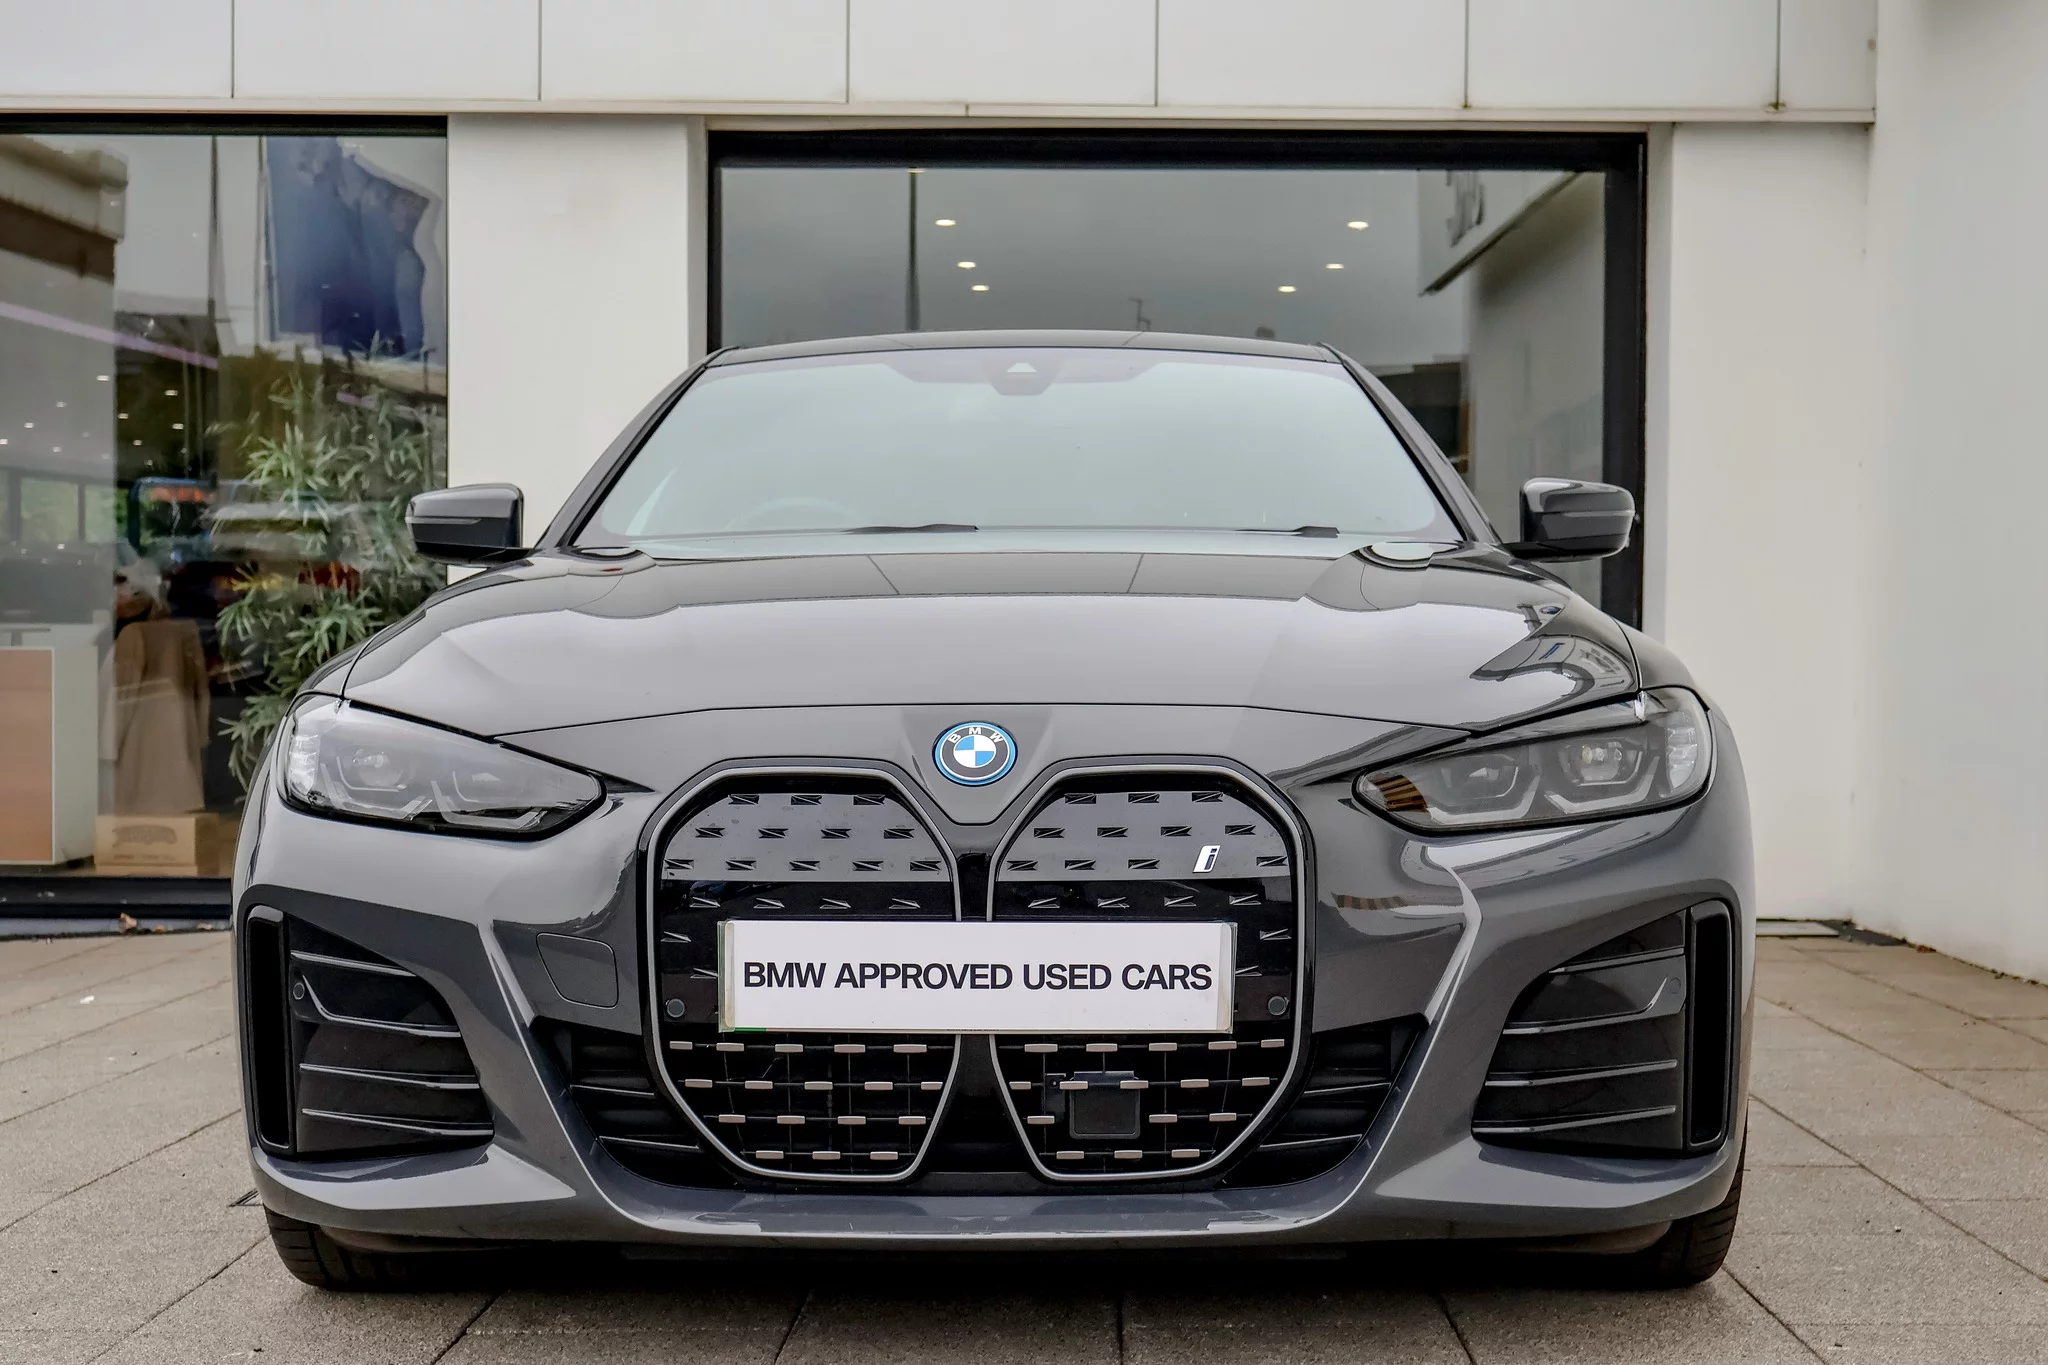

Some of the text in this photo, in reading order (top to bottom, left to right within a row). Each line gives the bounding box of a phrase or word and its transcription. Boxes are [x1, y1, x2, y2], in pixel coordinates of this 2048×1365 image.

[947, 726, 1004, 744] BMW
[744, 961, 1213, 991] BMW APPROVED USED CARS
